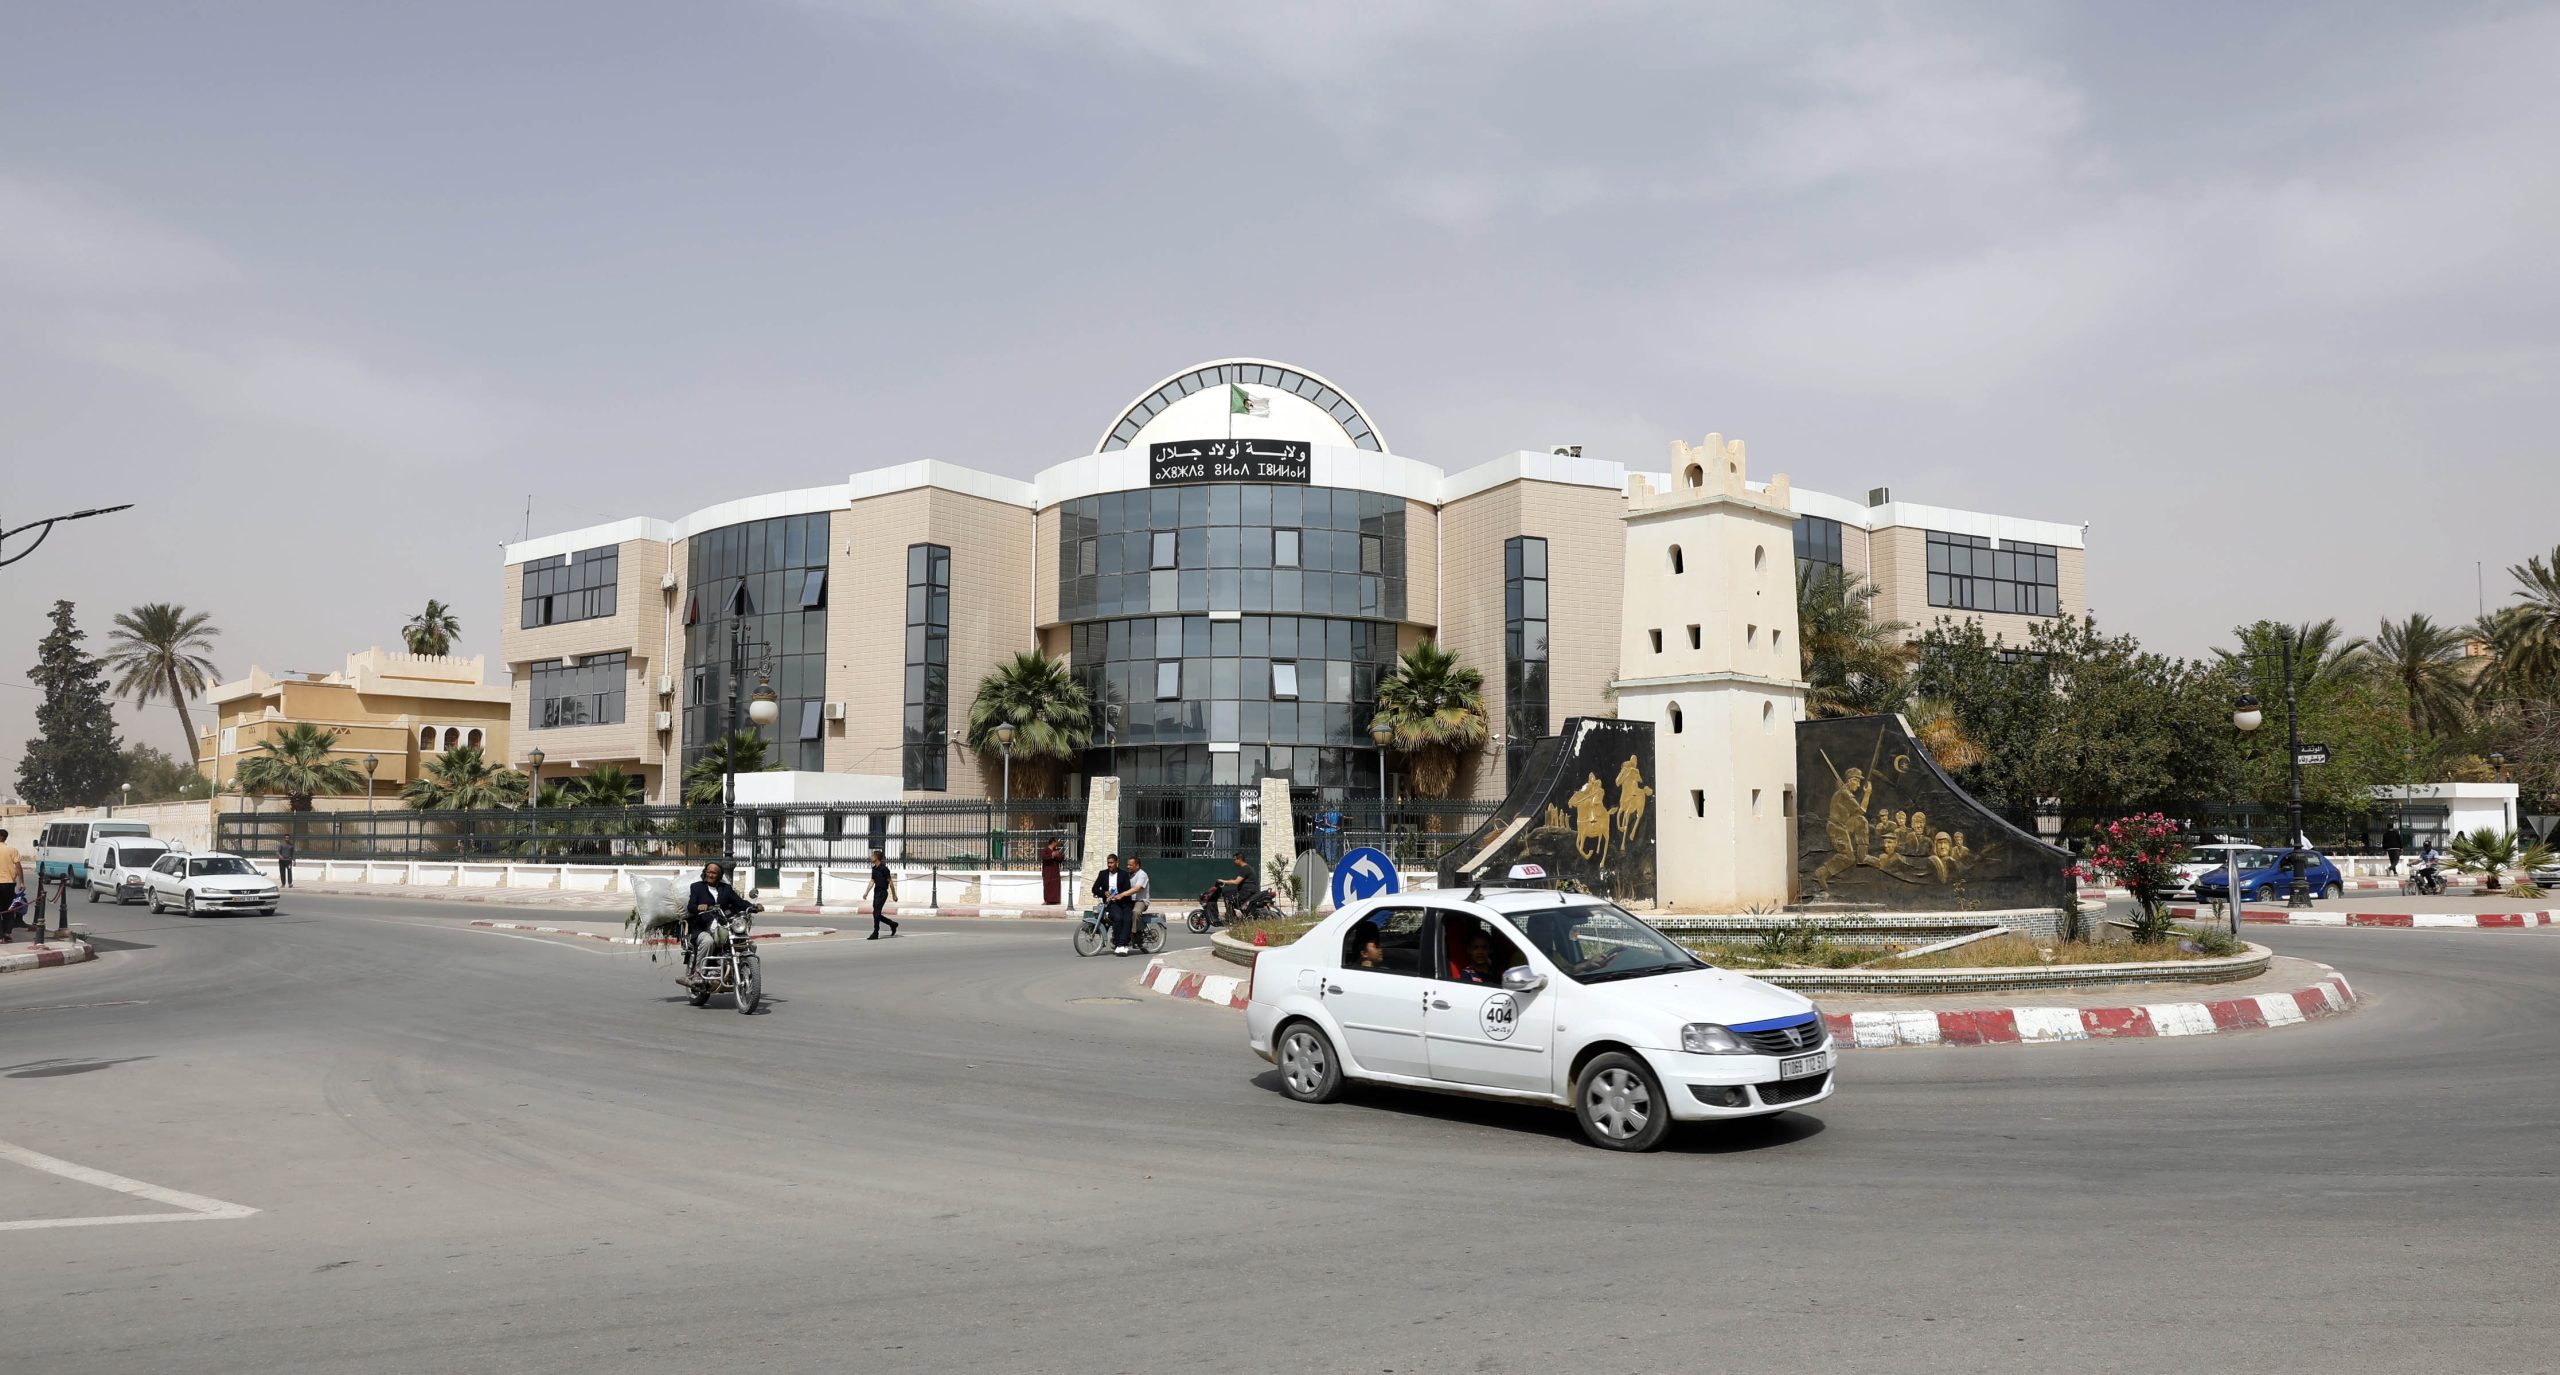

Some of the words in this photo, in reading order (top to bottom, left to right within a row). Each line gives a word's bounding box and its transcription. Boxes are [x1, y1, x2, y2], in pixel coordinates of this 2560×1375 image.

[1155, 446, 1202, 463] جلال
[1208, 441, 1239, 460] أولاد
[1246, 442, 1306, 462] ولاية
[1521, 865, 1543, 875] TAXI
[1486, 1007, 1513, 1024] 404
